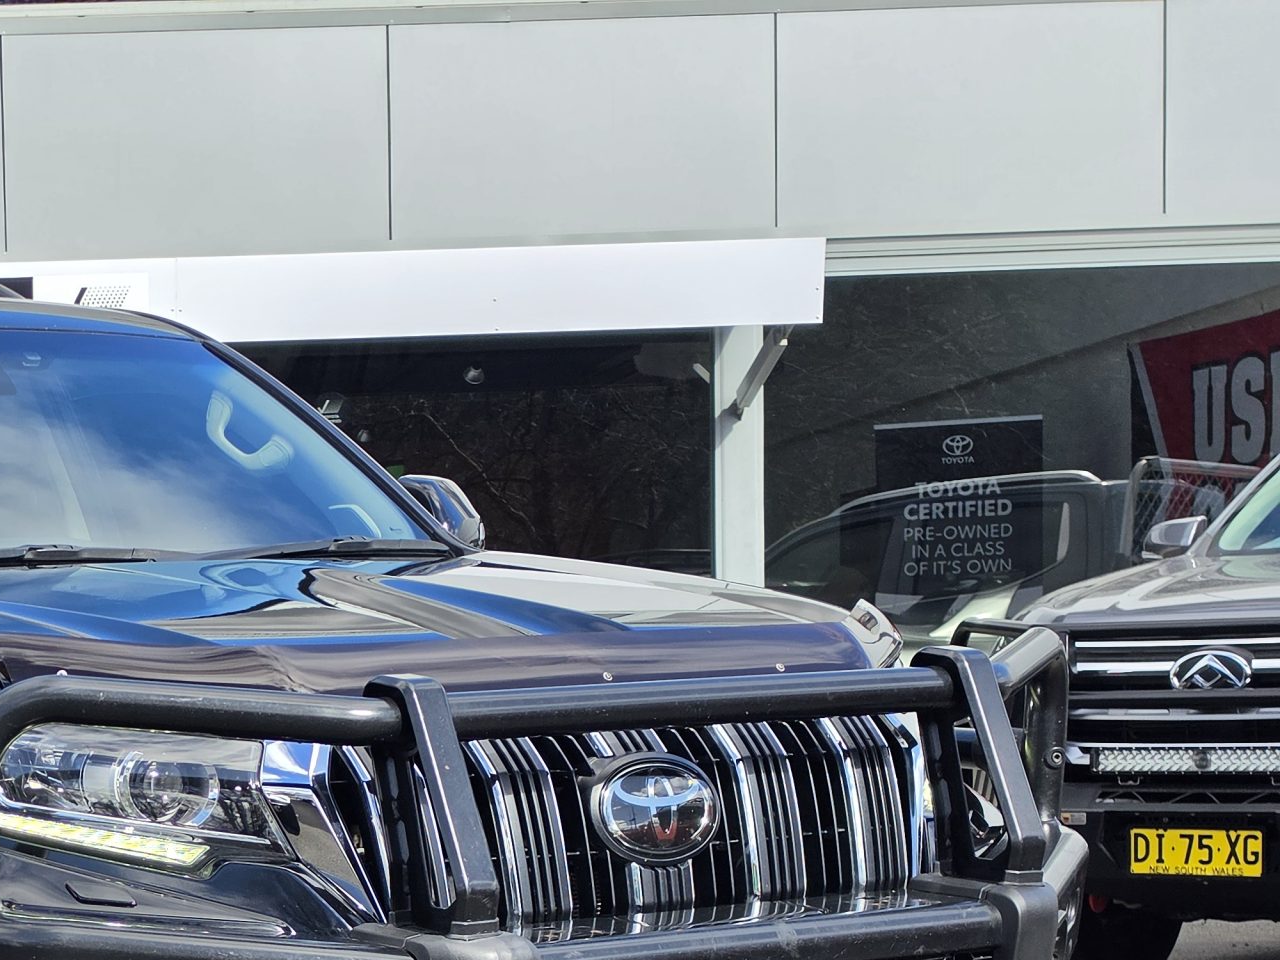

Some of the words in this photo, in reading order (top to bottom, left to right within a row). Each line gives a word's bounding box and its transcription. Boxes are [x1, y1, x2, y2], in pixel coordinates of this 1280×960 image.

[941, 456, 975, 464] TOYOTA
[914, 479, 1002, 499] TOYOTA
[903, 499, 1013, 521] CERTIFIED
[903, 523, 1013, 542] PRE-OWNED
[911, 544, 929, 559] IN
[934, 543, 947, 558] A
[950, 541, 1005, 558] CLASS
[903, 561, 929, 576] OF
[933, 560, 962, 576] IT'S
[966, 558, 1012, 574] OWN
[1149, 865, 1169, 874] NEW
[1175, 866, 1207, 875] SOUTH
[1211, 867, 1244, 876] WALES
